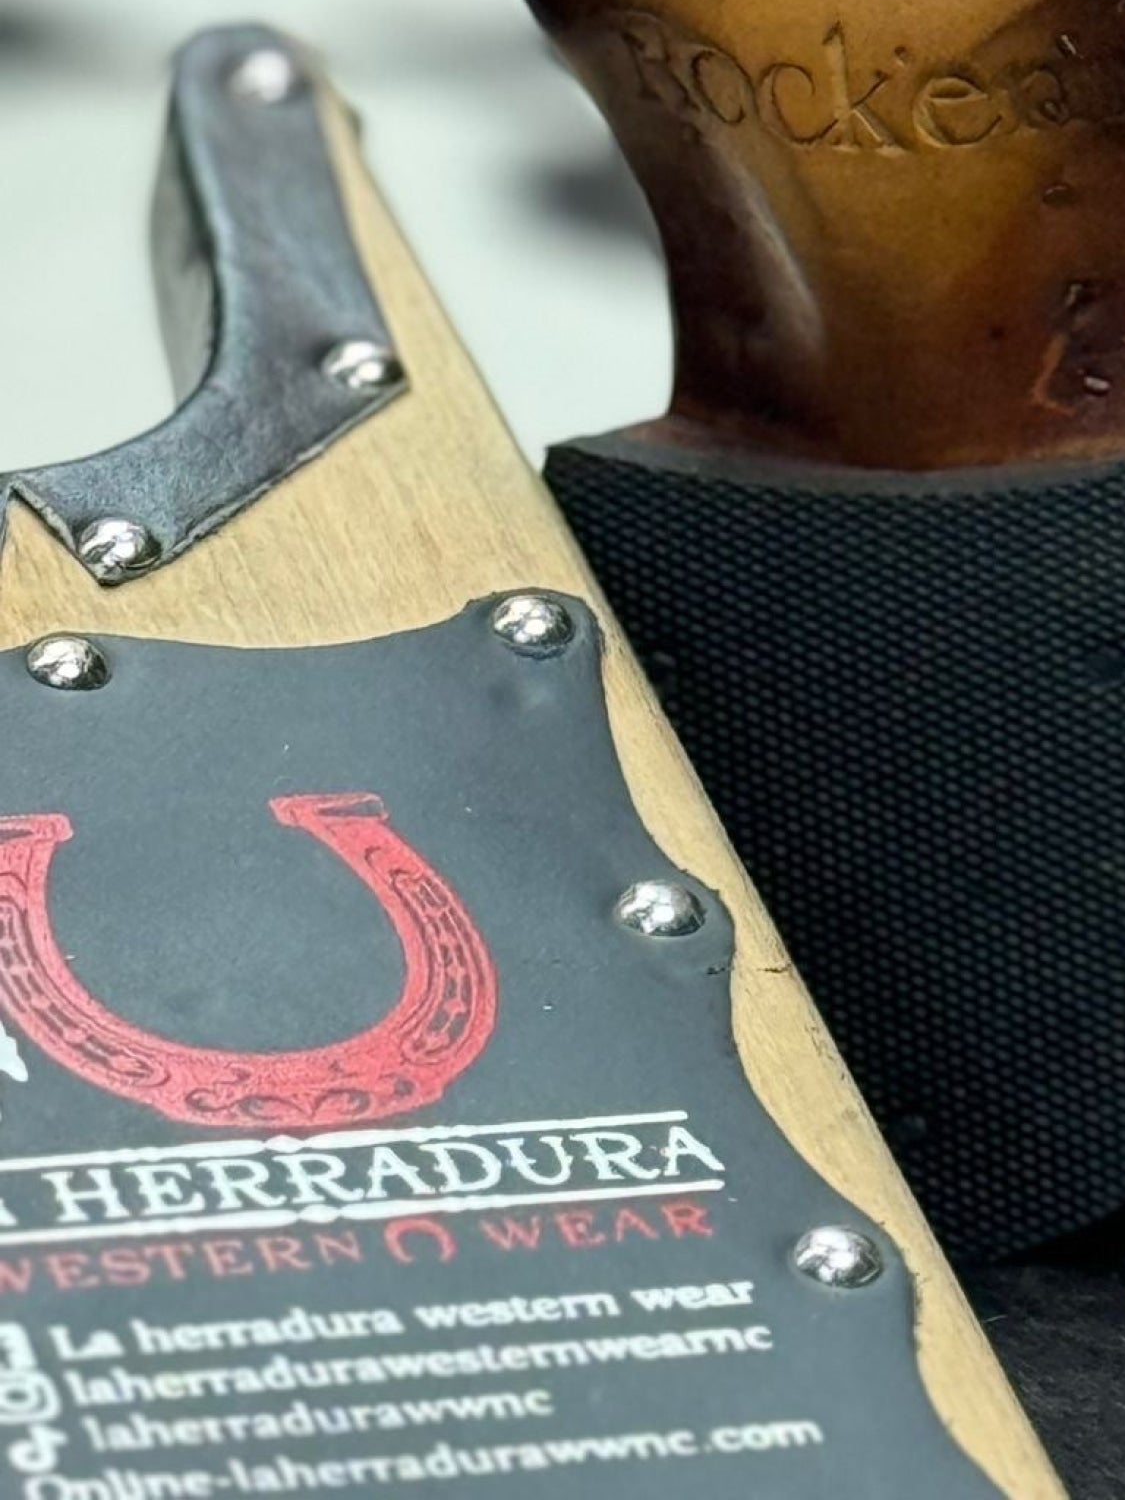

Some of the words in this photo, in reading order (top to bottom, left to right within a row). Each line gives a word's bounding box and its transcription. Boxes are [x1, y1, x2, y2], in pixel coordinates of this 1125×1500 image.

[41, 1125, 726, 1223] HERRADURA
[478, 1201, 714, 1251] WEAR
[49, 1325, 125, 1361] La
[130, 1305, 406, 1355] herradura
[413, 1292, 621, 1330] western
[630, 1280, 755, 1313] wear
[63, 1325, 774, 1406] laherradurawesternwearnc
[82, 1388, 556, 1452] laherradurawwnc
